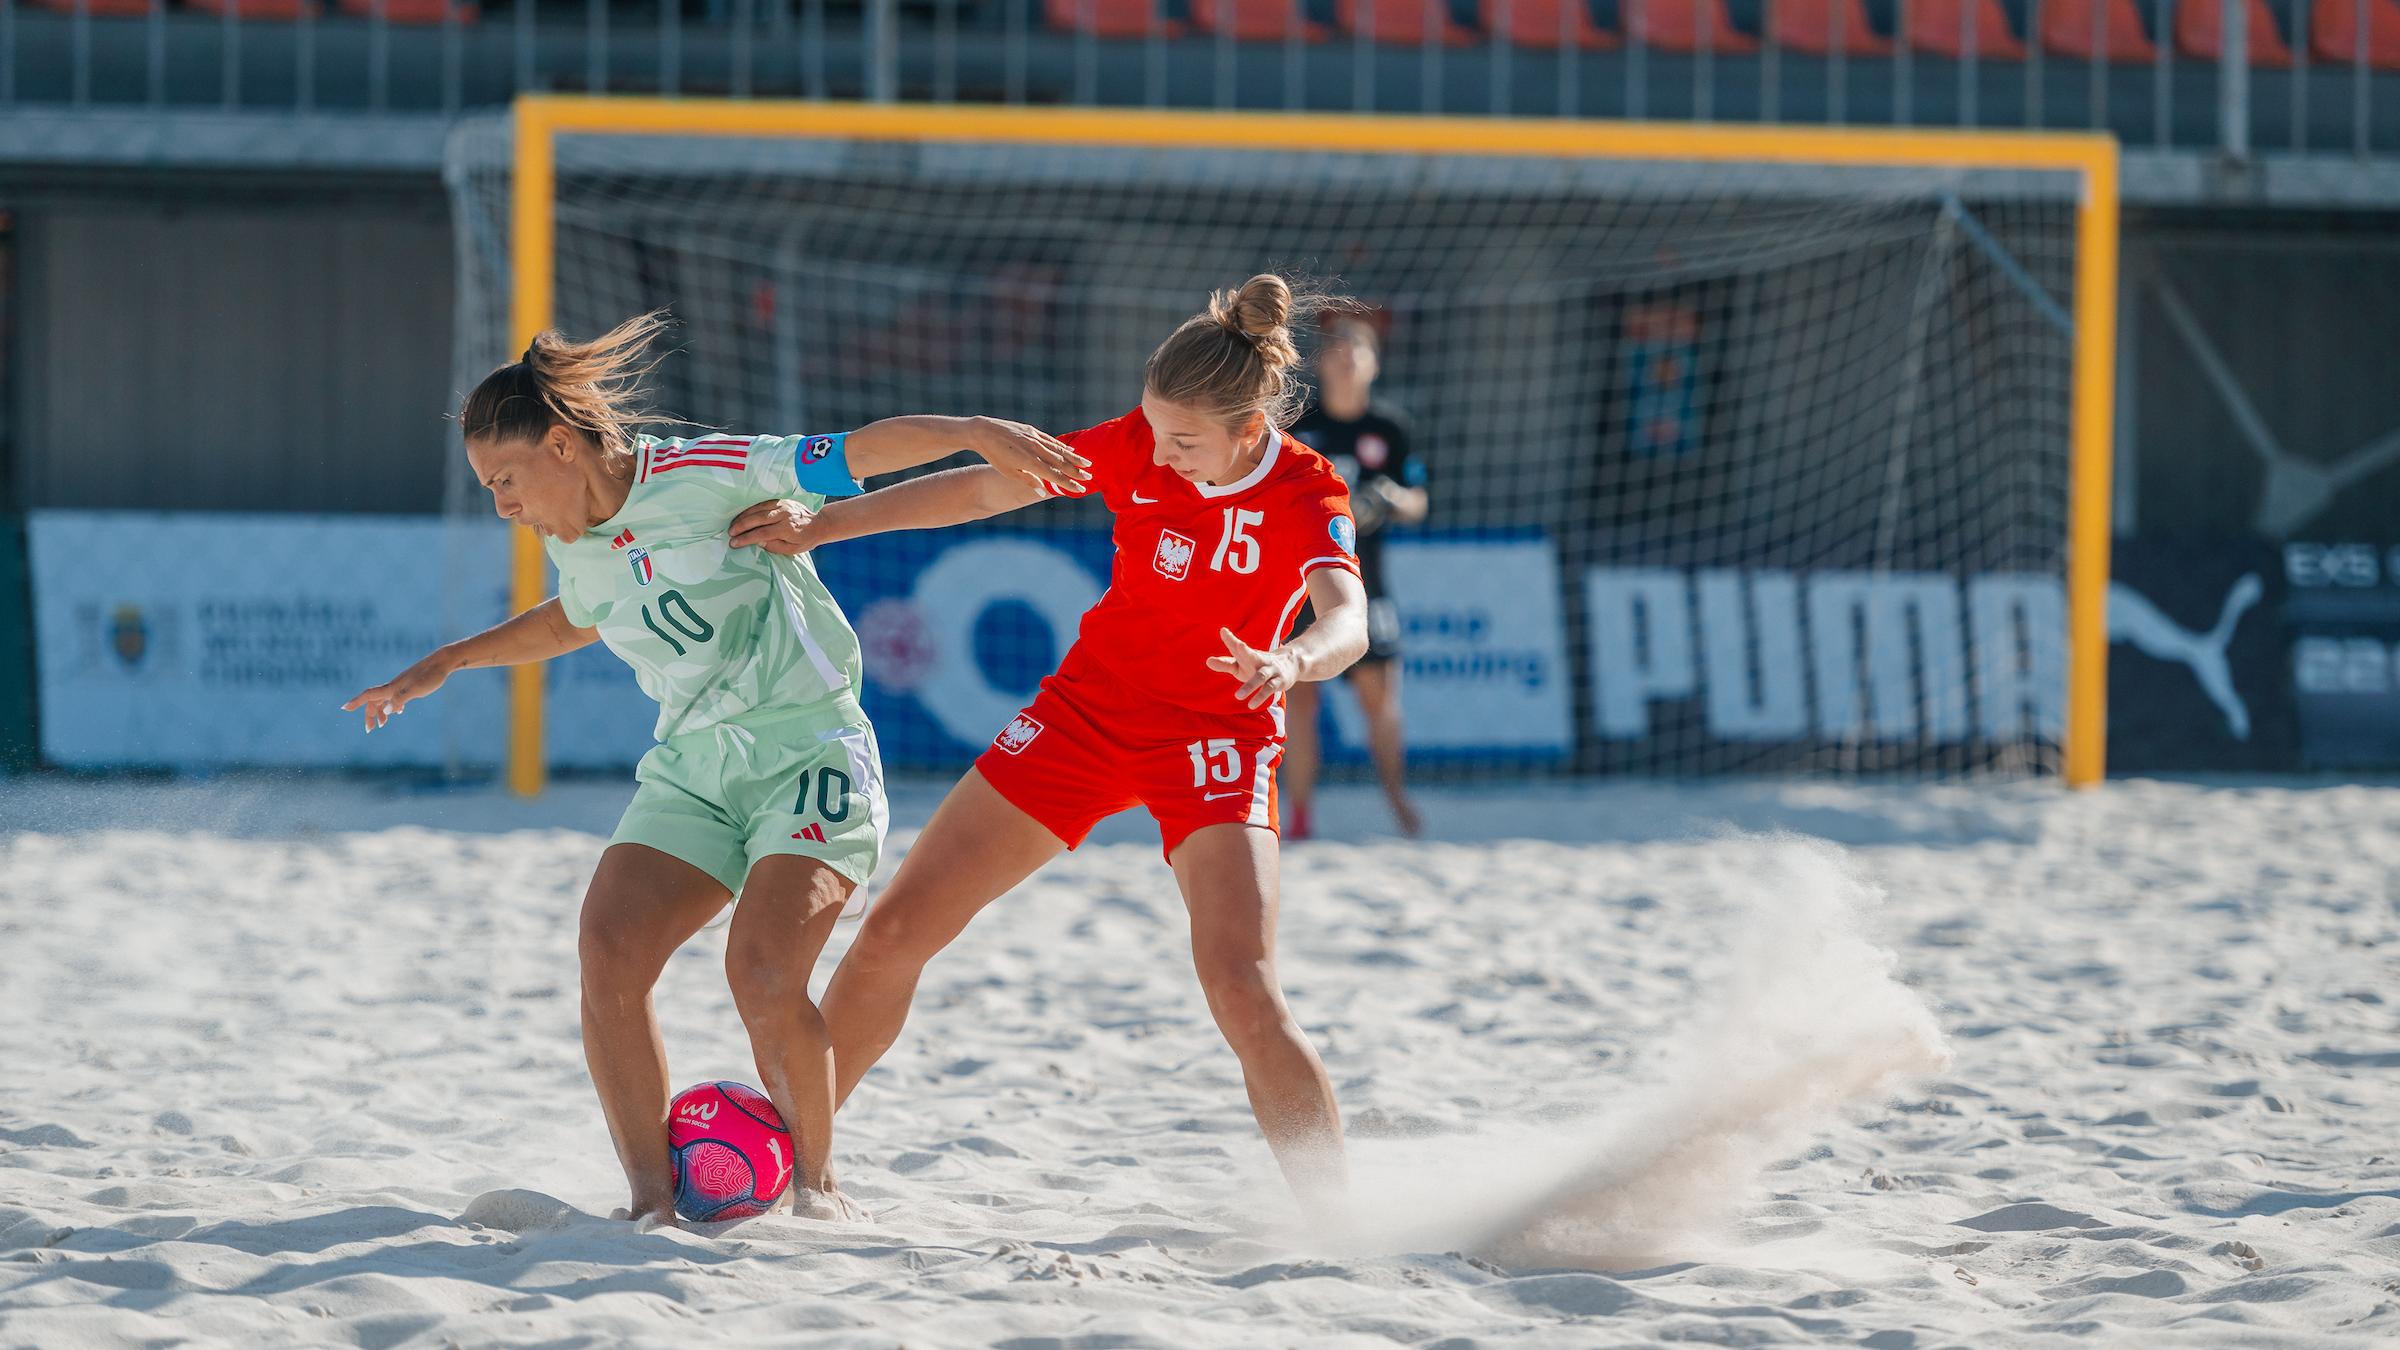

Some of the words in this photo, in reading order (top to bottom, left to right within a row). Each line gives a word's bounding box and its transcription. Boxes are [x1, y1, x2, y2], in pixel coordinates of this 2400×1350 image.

[628, 547, 646, 562] ITALIA
[1210, 506, 1264, 574] 15
[641, 589, 714, 656] 10
[1588, 567, 2067, 741] PUMA
[1187, 738, 1242, 788] 15
[794, 767, 850, 823] 10
